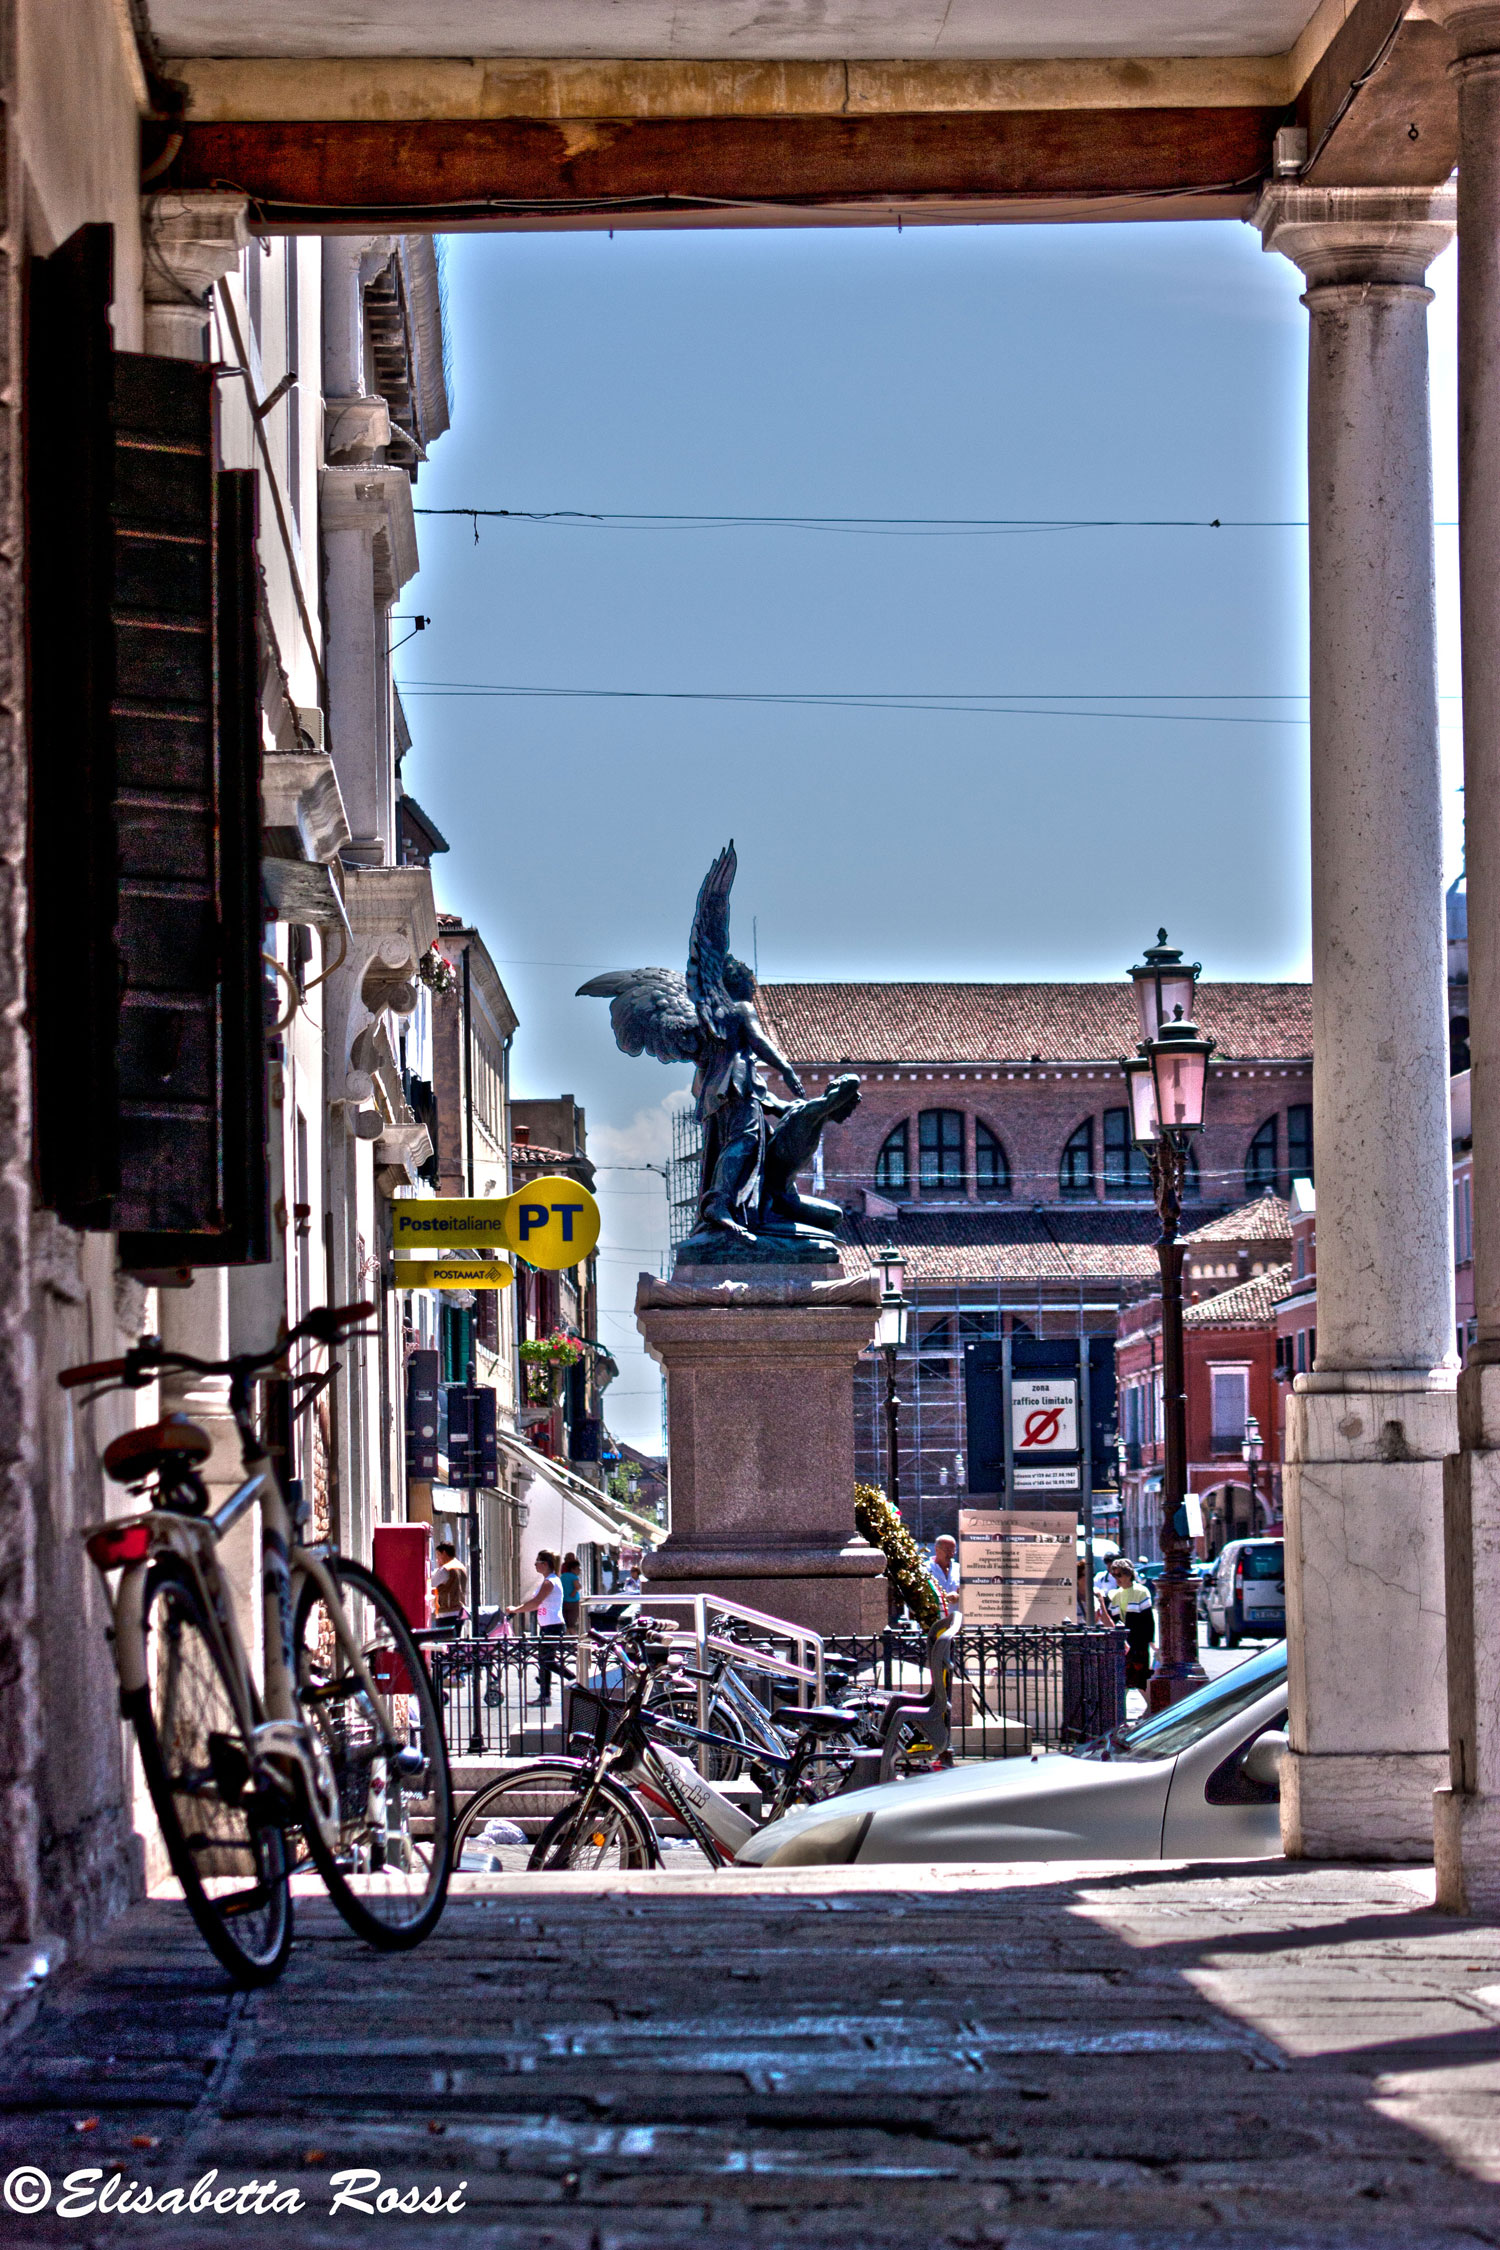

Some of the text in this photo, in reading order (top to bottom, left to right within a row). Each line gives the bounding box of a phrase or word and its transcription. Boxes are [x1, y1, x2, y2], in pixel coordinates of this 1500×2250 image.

[399, 1216, 501, 1231] Posteitaliane
[518, 1204, 583, 1241] PT
[433, 1270, 485, 1280] POSTAMAT
[1012, 1396, 1073, 1405] raffico limitato
[656, 1770, 706, 1845] Shockblaze
